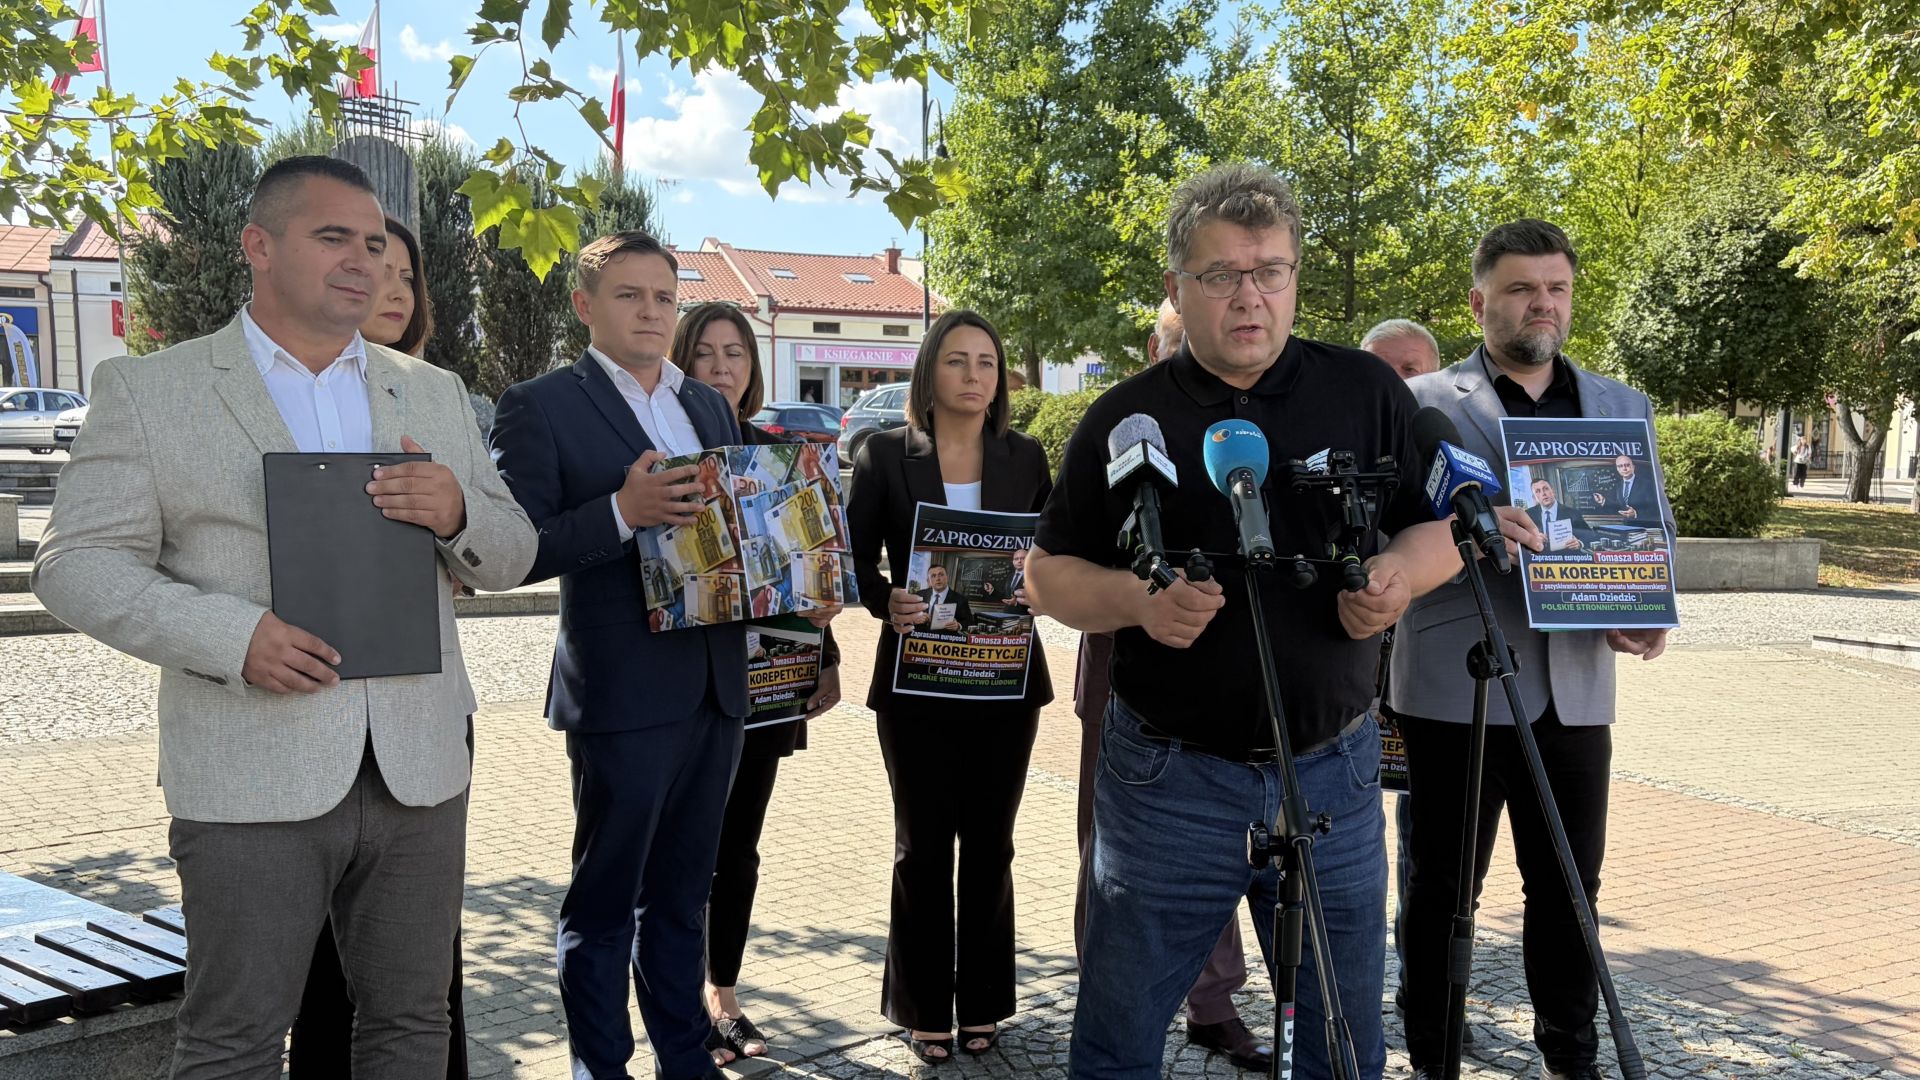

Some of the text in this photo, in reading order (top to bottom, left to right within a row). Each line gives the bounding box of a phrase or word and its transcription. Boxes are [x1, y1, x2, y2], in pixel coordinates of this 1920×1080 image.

[824, 349, 918, 361] KSIĘGARNIE NO
[1514, 441, 1643, 456] ZAPROSZENIE
[798, 489, 819, 511] 200
[1531, 553, 1664, 562] Zapraszam europosła Tomasza Buczka
[1533, 566, 1666, 580] NA KOREPETYCJE
[1571, 593, 1636, 601] Adam Dziedzic
[910, 630, 1027, 645] Zapraszam europosła Tomasza Buczka
[908, 641, 1025, 659] NA KOREPETYCJE
[773, 656, 795, 666] Tomasza
[749, 665, 816, 686] KOREPETYCJE
[908, 672, 937, 682] POLSKIE
[939, 676, 989, 685] STRONNICTWO
[937, 666, 995, 678] Adam Dziedzic
[755, 691, 795, 704] Adam Dziedzic
[1390, 763, 1408, 771] Dzie
